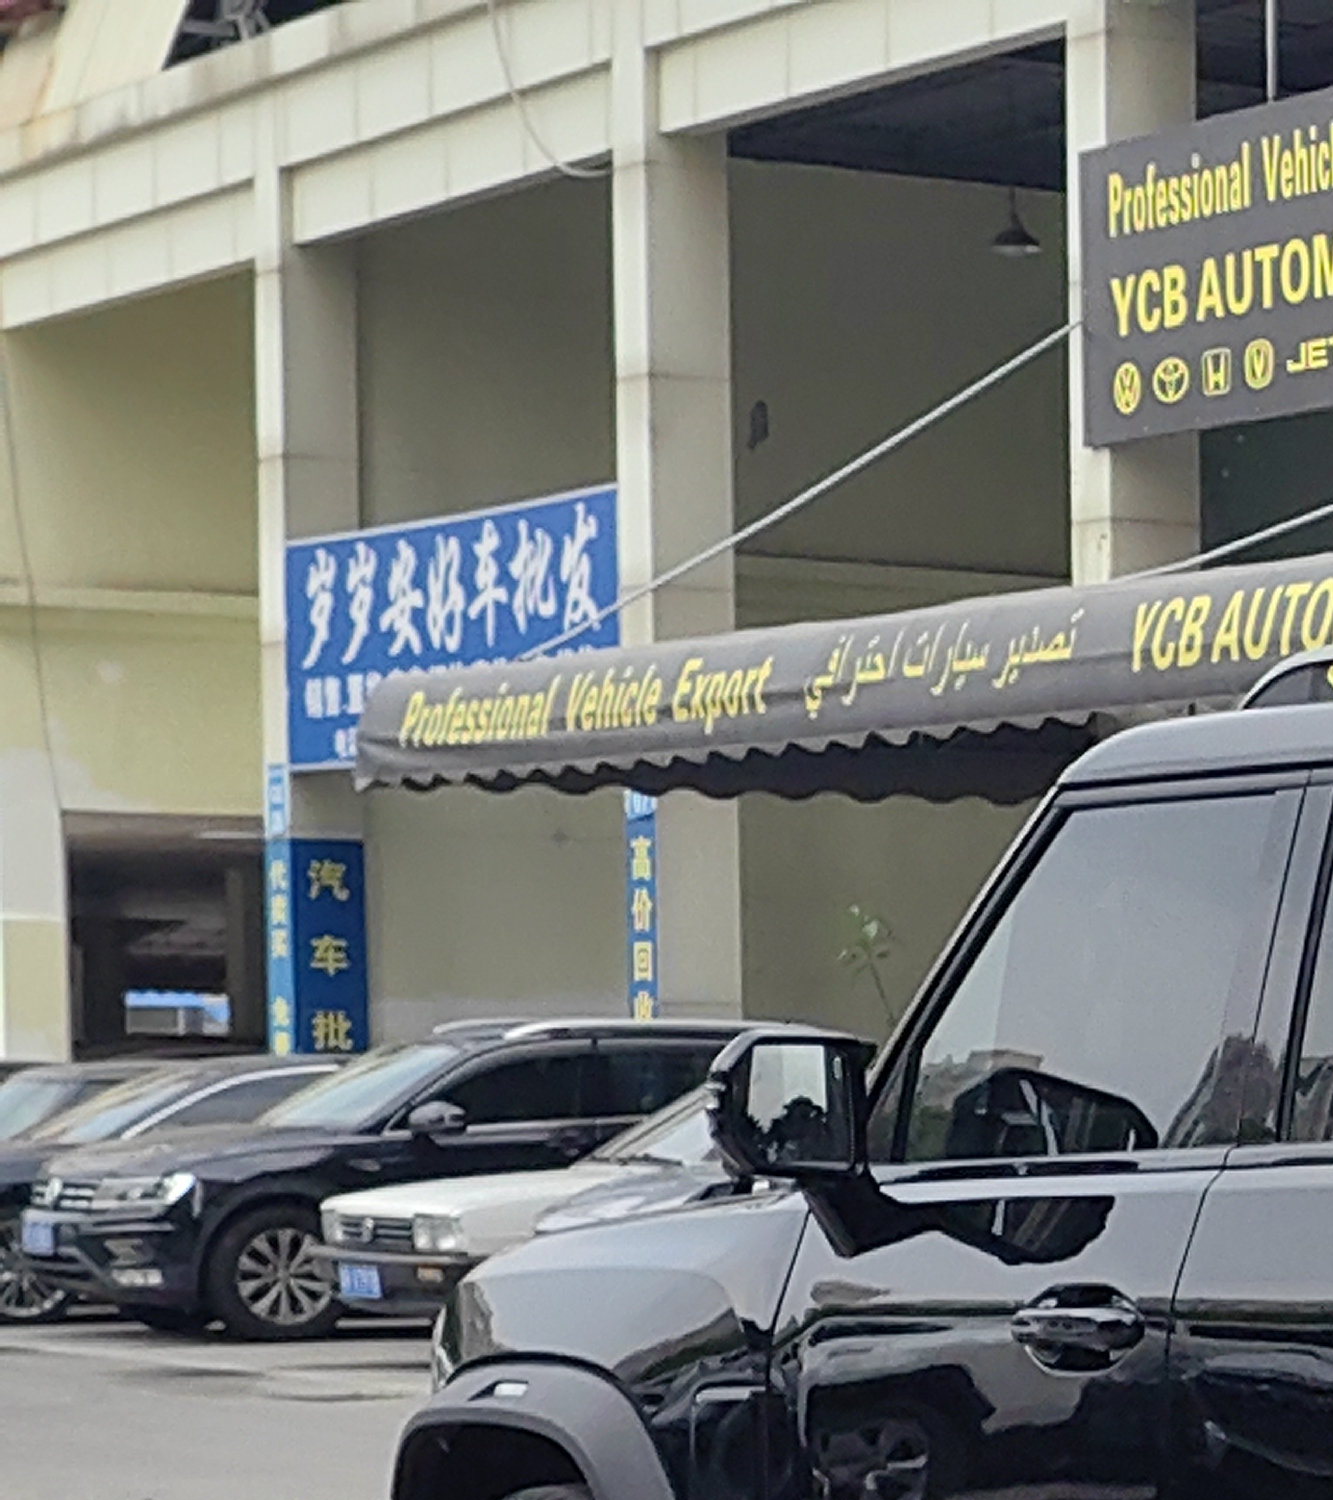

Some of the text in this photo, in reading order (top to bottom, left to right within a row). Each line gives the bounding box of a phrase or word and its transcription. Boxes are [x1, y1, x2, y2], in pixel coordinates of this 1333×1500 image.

[1107, 141, 1252, 237] Professional
[1109, 264, 1189, 337] YCB
[803, 626, 906, 720] احترافي
[902, 620, 988, 696] سيارات
[1131, 596, 1211, 672] YCB
[400, 673, 562, 748] Professional
[564, 663, 663, 732] Vehicle
[672, 655, 774, 735] Export
[308, 859, 352, 1050] 汽车批
